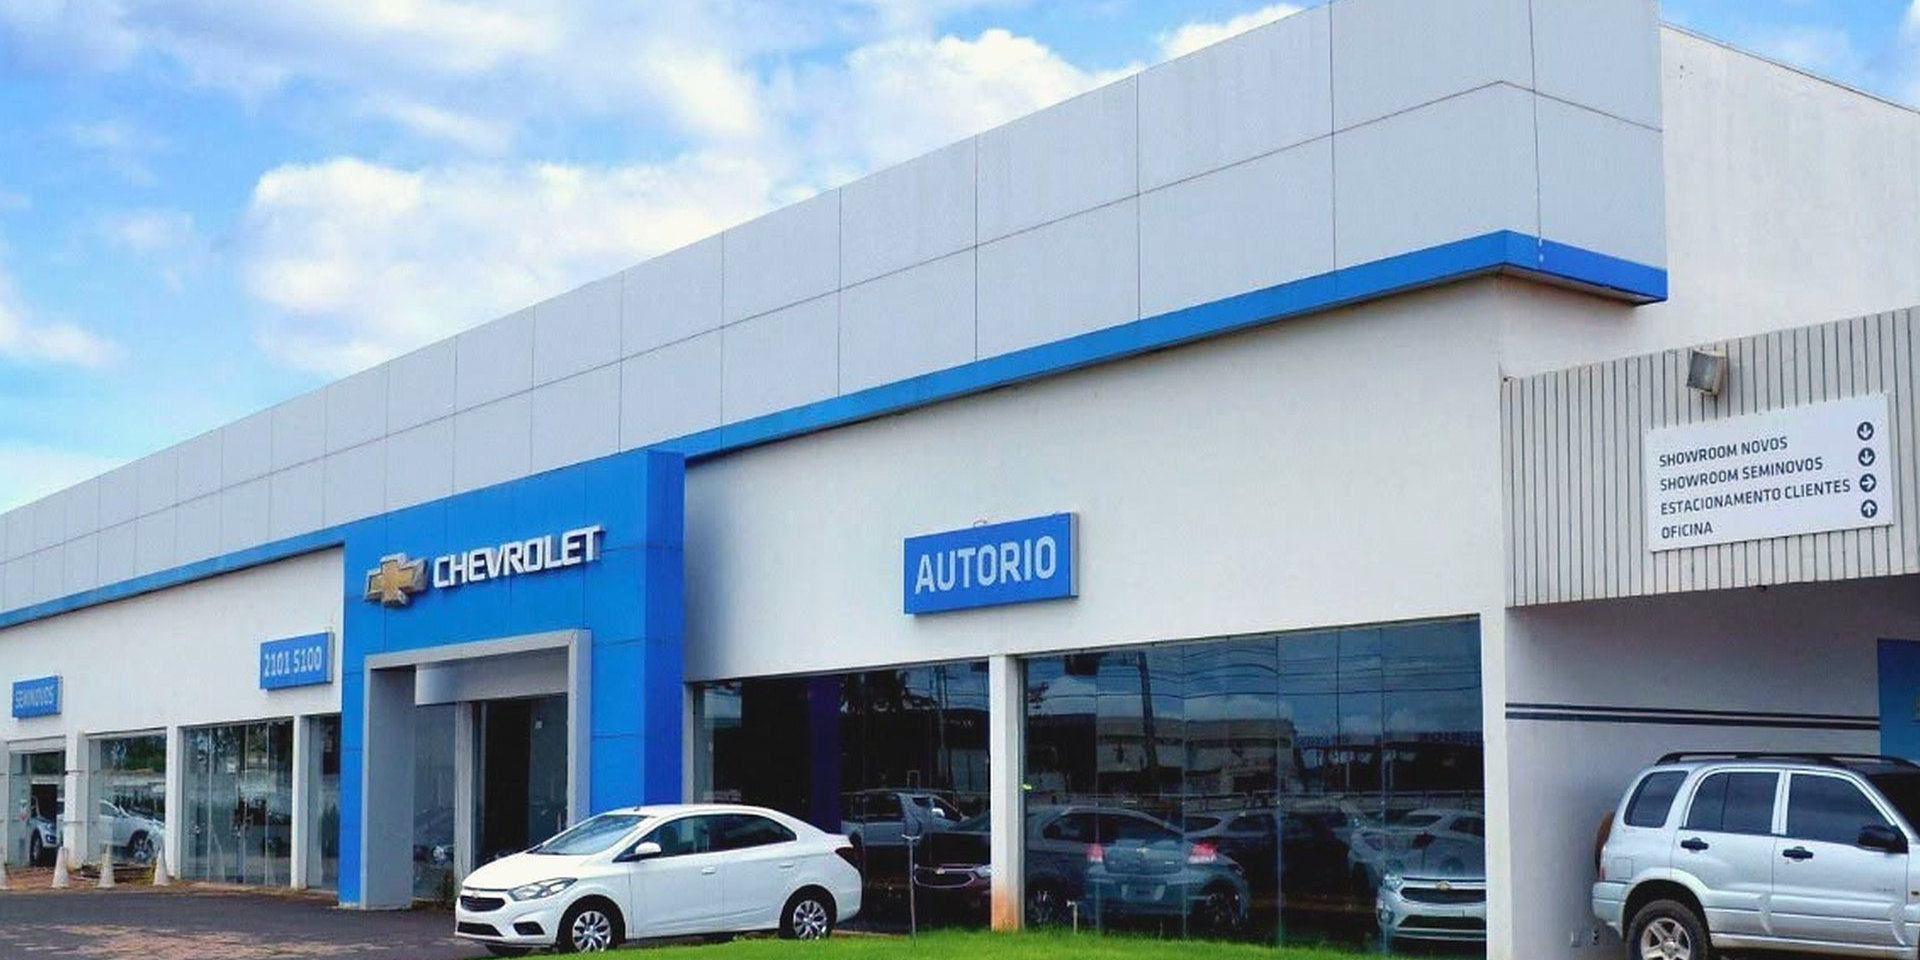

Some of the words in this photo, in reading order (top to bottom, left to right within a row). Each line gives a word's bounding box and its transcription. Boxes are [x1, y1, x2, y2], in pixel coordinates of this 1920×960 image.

[1659, 444, 1738, 467] SHOWROOM
[1741, 436, 1788, 455] NOVOS
[1660, 468, 1739, 491] SHOWROOM
[1742, 456, 1823, 480] SEMINOVOS
[1660, 488, 1781, 515] ESTACIONAMENTO
[1784, 479, 1851, 500] CLIENTES
[1661, 521, 1714, 539] OFICINA
[432, 525, 604, 589] CHEVROLET
[914, 535, 1057, 595] AUTORIO
[264, 650, 290, 677] 2101
[293, 645, 322, 674] 5100
